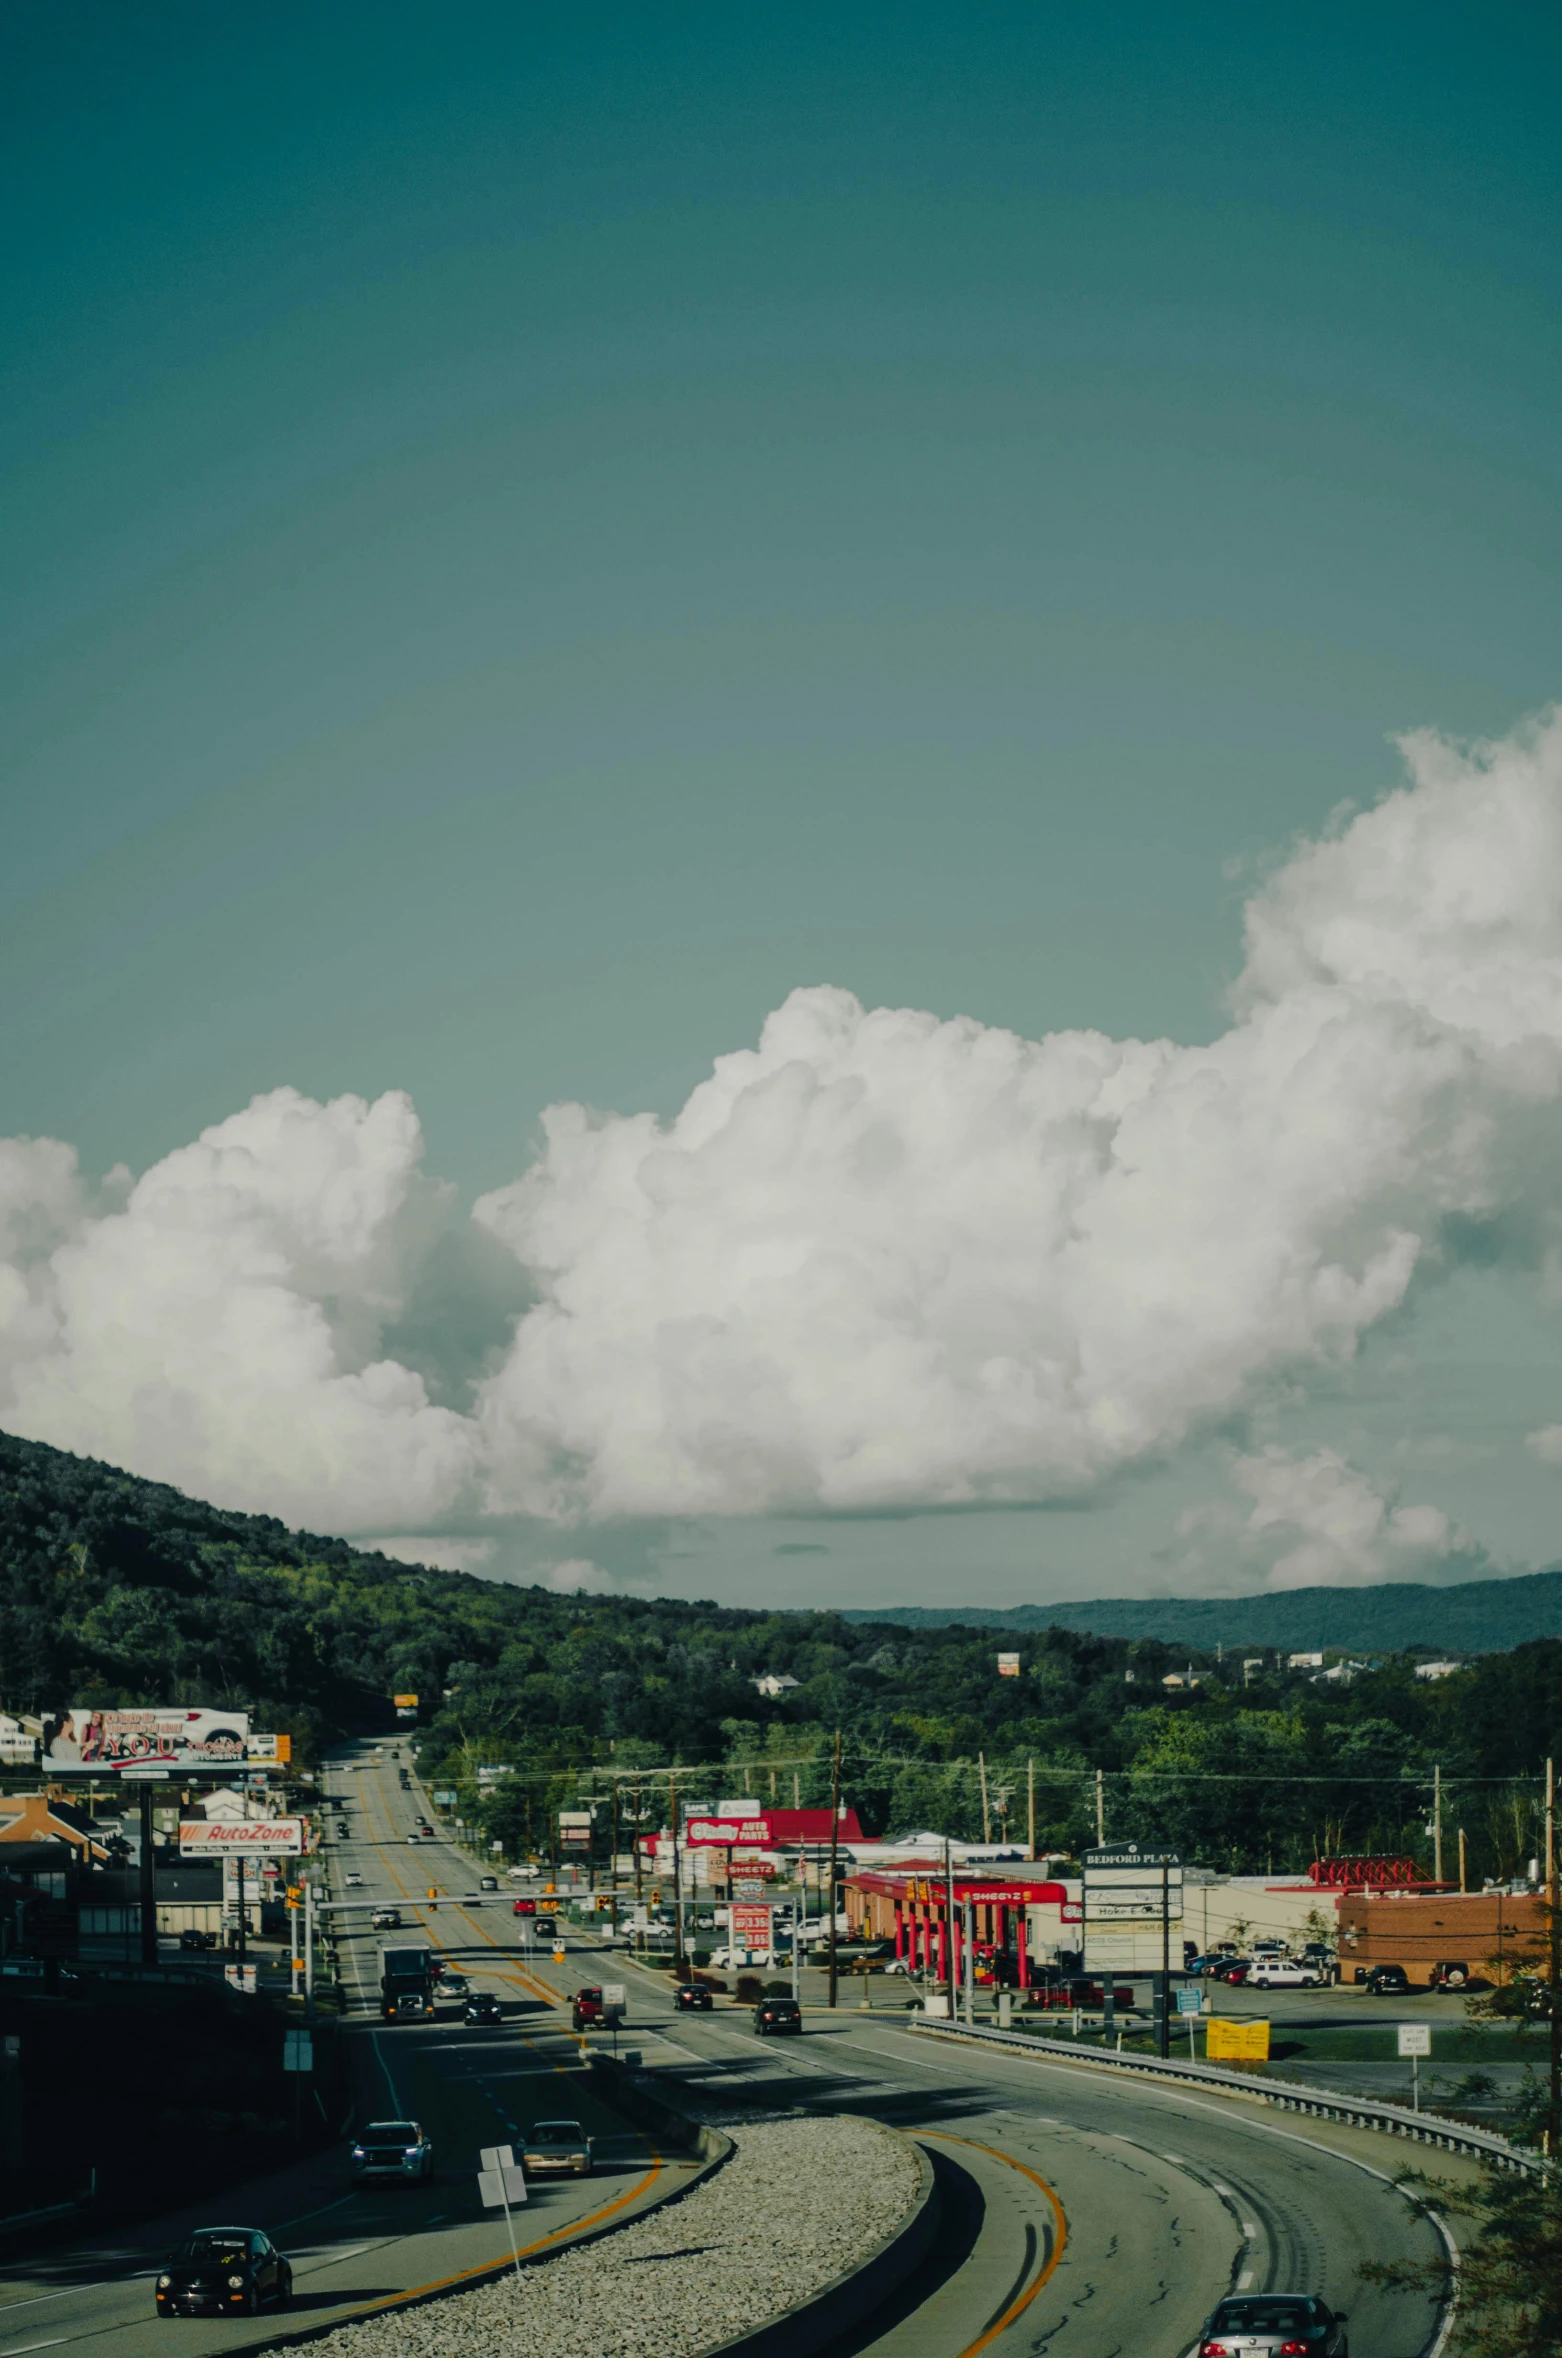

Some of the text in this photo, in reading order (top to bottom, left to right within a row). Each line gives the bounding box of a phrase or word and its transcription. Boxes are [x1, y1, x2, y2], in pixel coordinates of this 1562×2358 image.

[187, 1741, 243, 1753] THOMAS
[742, 1822, 768, 1831] AUTO
[208, 1825, 294, 1840] AutoZone
[691, 1822, 739, 1841] O'Reilly
[739, 1831, 770, 1840] PARTS
[1086, 1855, 1141, 1864] BEDFORD
[972, 1892, 1021, 1901] SHEETZ
